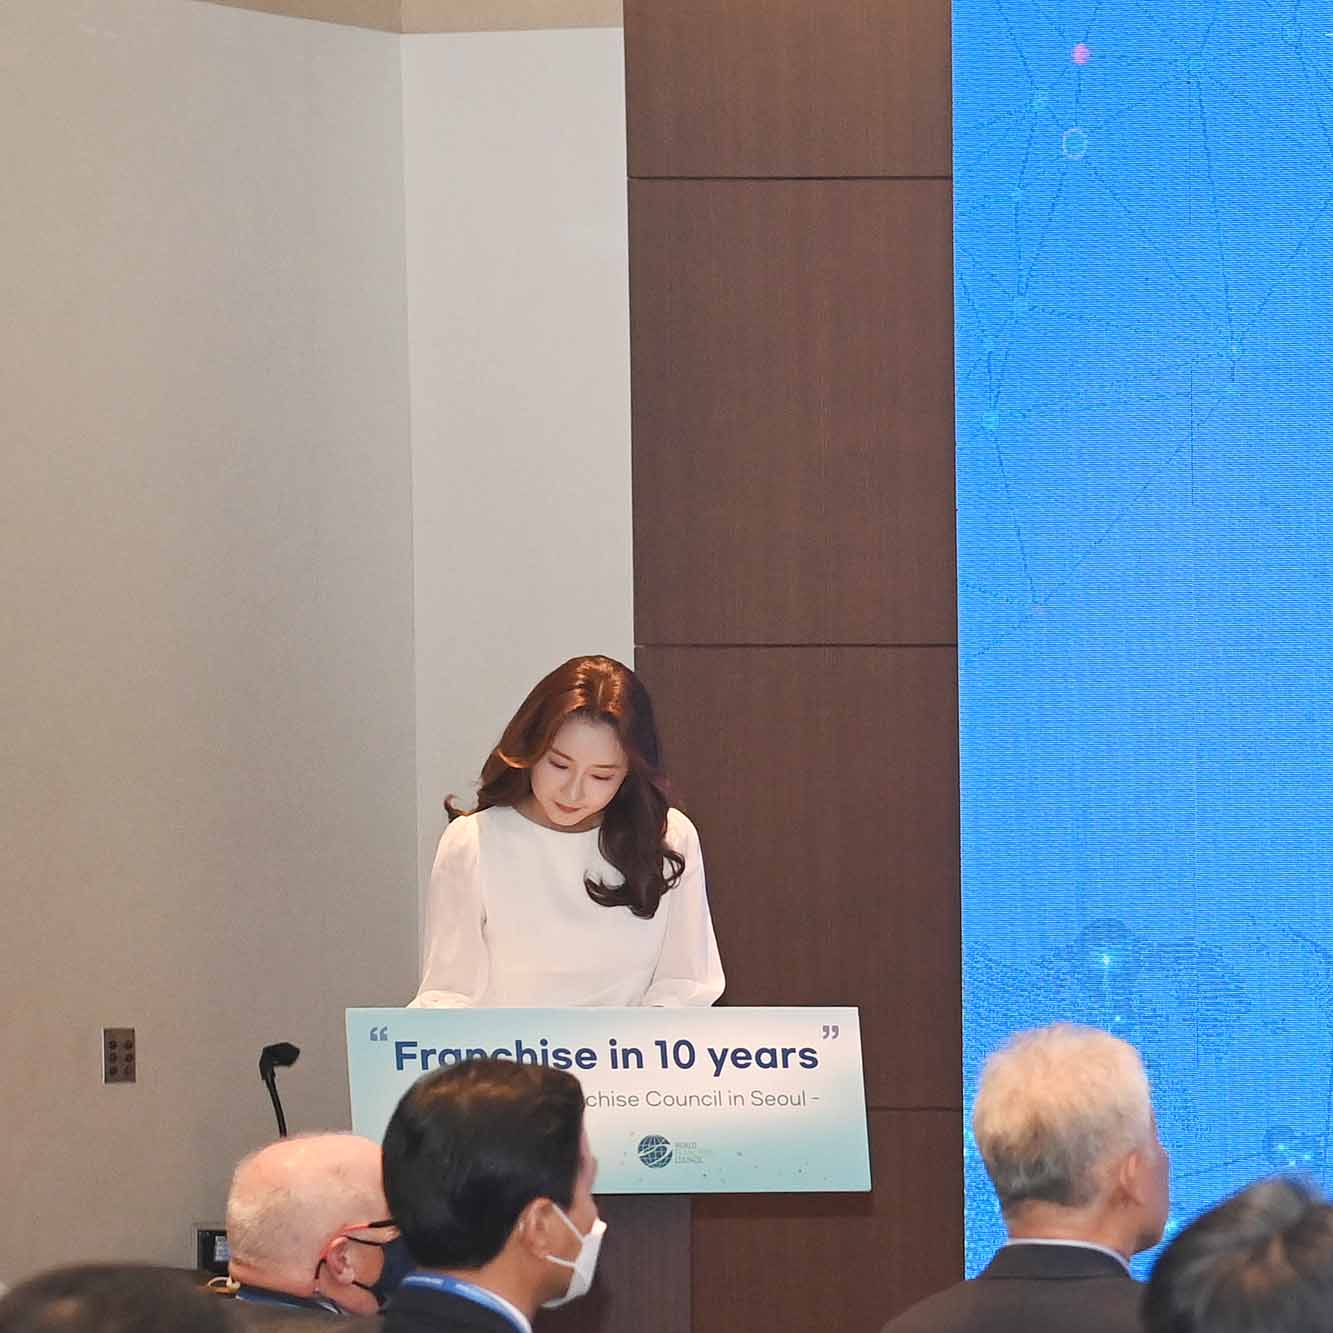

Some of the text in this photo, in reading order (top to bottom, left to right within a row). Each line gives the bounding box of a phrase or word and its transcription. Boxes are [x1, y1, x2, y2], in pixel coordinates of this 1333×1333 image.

[608, 1037, 645, 1070] in
[653, 1039, 696, 1070] 10
[645, 1089, 723, 1108] Council
[728, 1089, 745, 1107] in
[750, 1088, 806, 1107] Seoul
